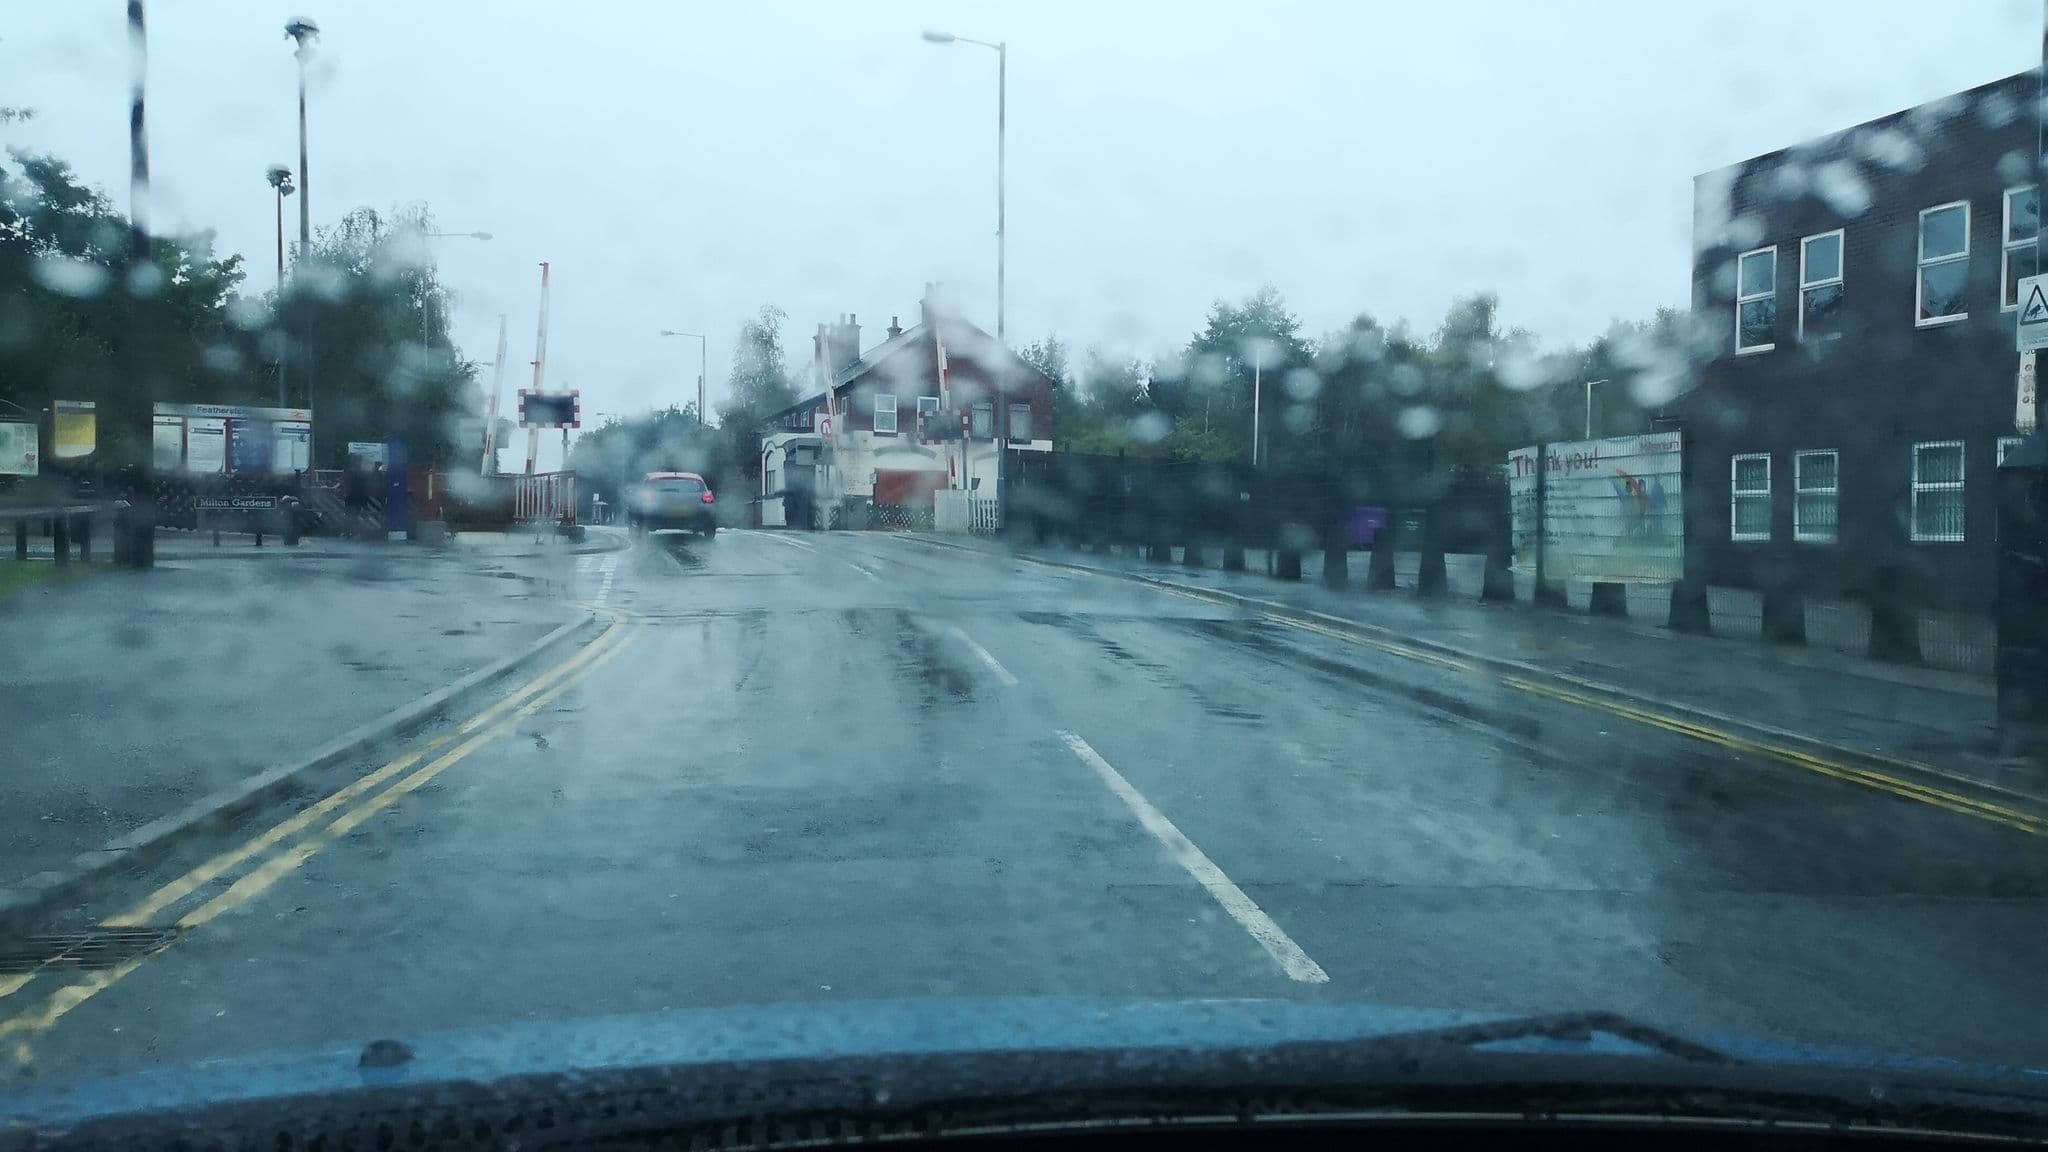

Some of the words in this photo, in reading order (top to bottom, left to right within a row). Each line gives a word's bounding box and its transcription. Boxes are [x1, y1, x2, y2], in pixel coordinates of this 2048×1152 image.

[197, 406, 248, 414] Featherst
[1512, 448, 1561, 476] Thnk
[1565, 445, 1598, 477] you!
[200, 497, 230, 507] Milton
[231, 497, 272, 508] Gardens
